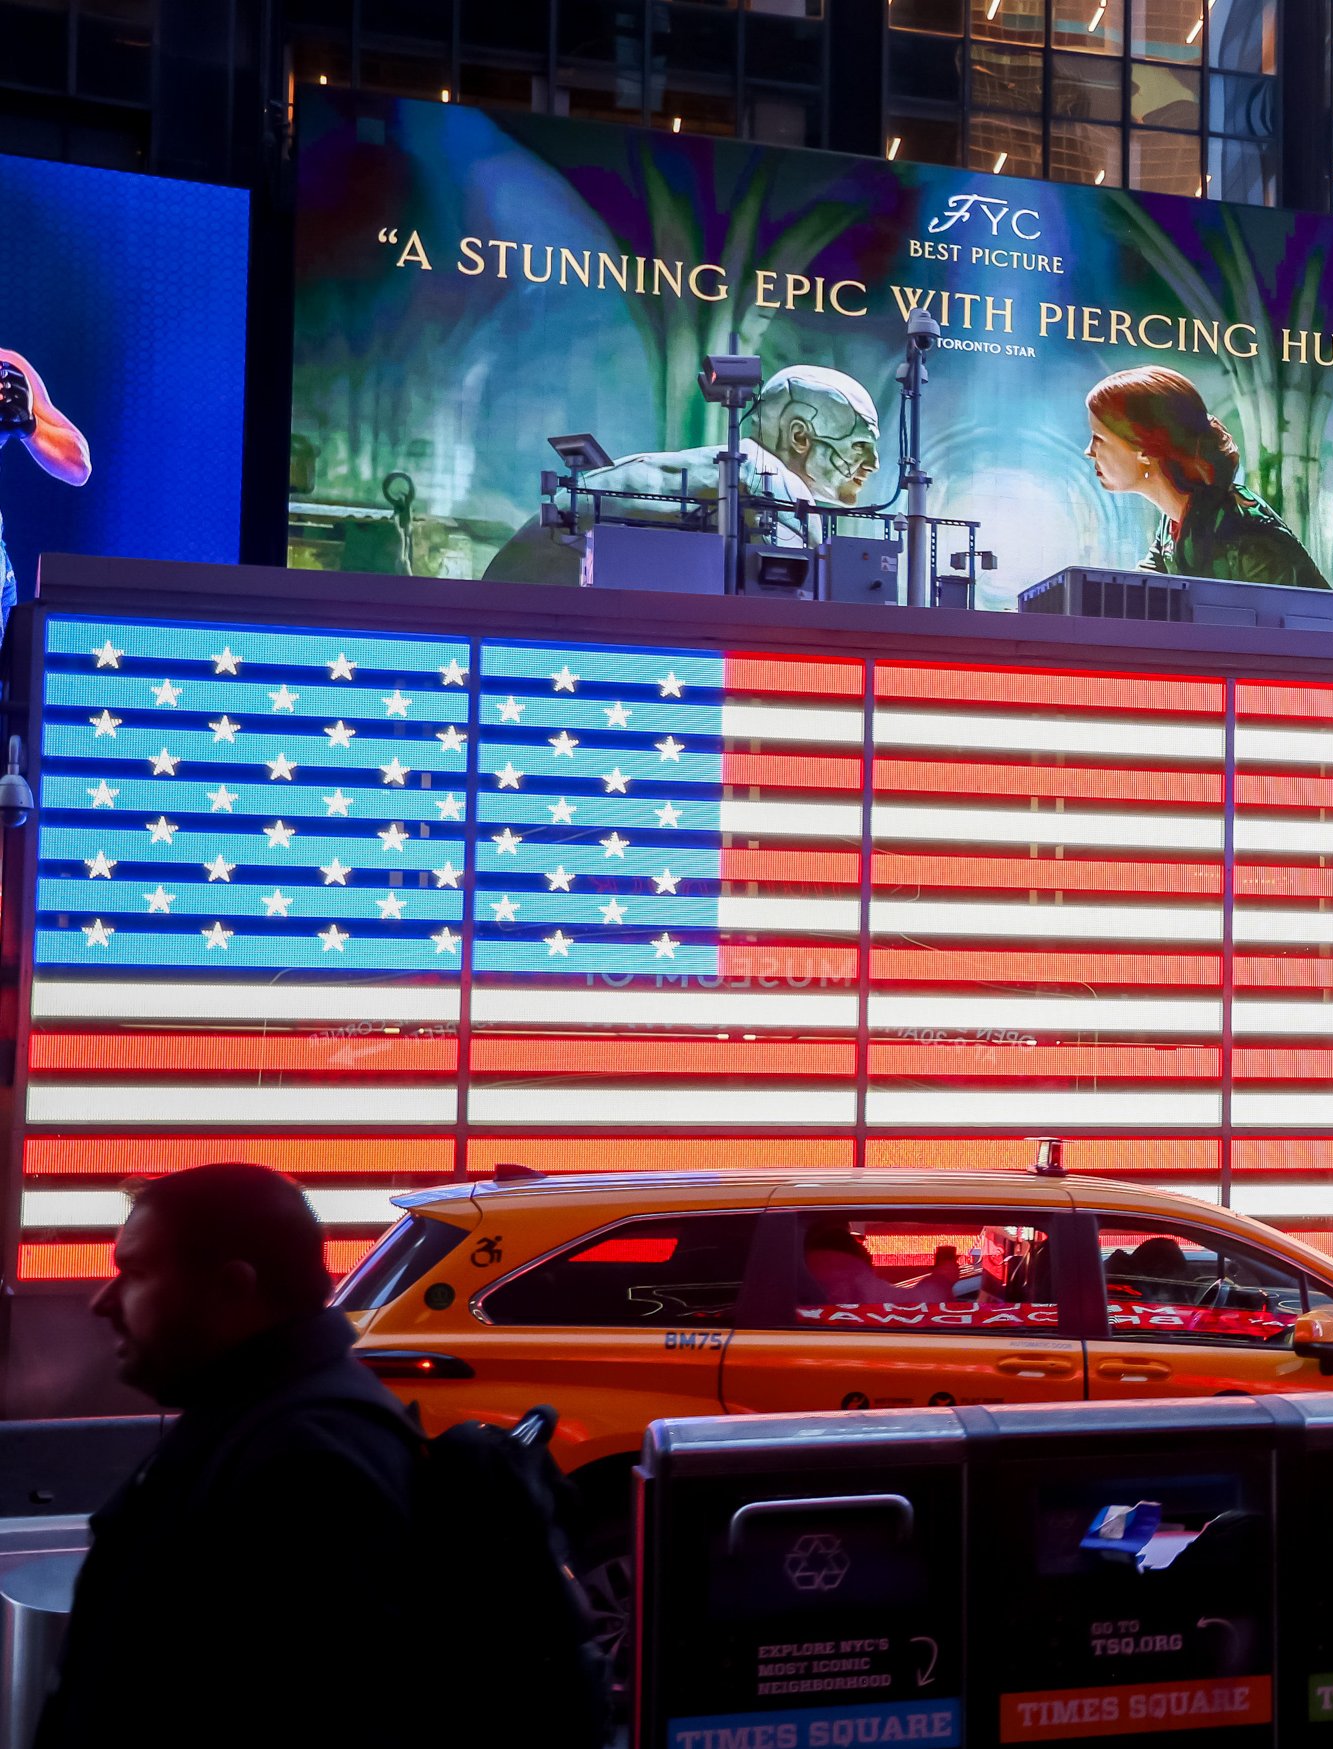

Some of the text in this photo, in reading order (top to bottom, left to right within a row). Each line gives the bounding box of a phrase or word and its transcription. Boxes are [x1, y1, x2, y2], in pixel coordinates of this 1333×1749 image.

[927, 193, 1041, 240] FYC
[909, 239, 1064, 274] BEST PICTURE
[457, 236, 728, 303] STUNNING
[755, 270, 868, 317] EPIC
[890, 285, 1014, 333] WITH
[1038, 302, 1258, 358] PIERCING
[936, 337, 1036, 358] TORONTO STAR
[664, 1331, 723, 1351] BM75
[1090, 1620, 1140, 1636] GO TO
[758, 1638, 889, 1659] EXPLORE NYC'S
[1092, 1633, 1183, 1656] TSQ.ORG
[758, 1657, 871, 1677] MOST ICONIC
[757, 1674, 892, 1695] NEIGHBORHOOD
[1018, 1686, 1250, 1727] TIMES SQUARE
[676, 1711, 952, 1749] TIMES SQUARE
